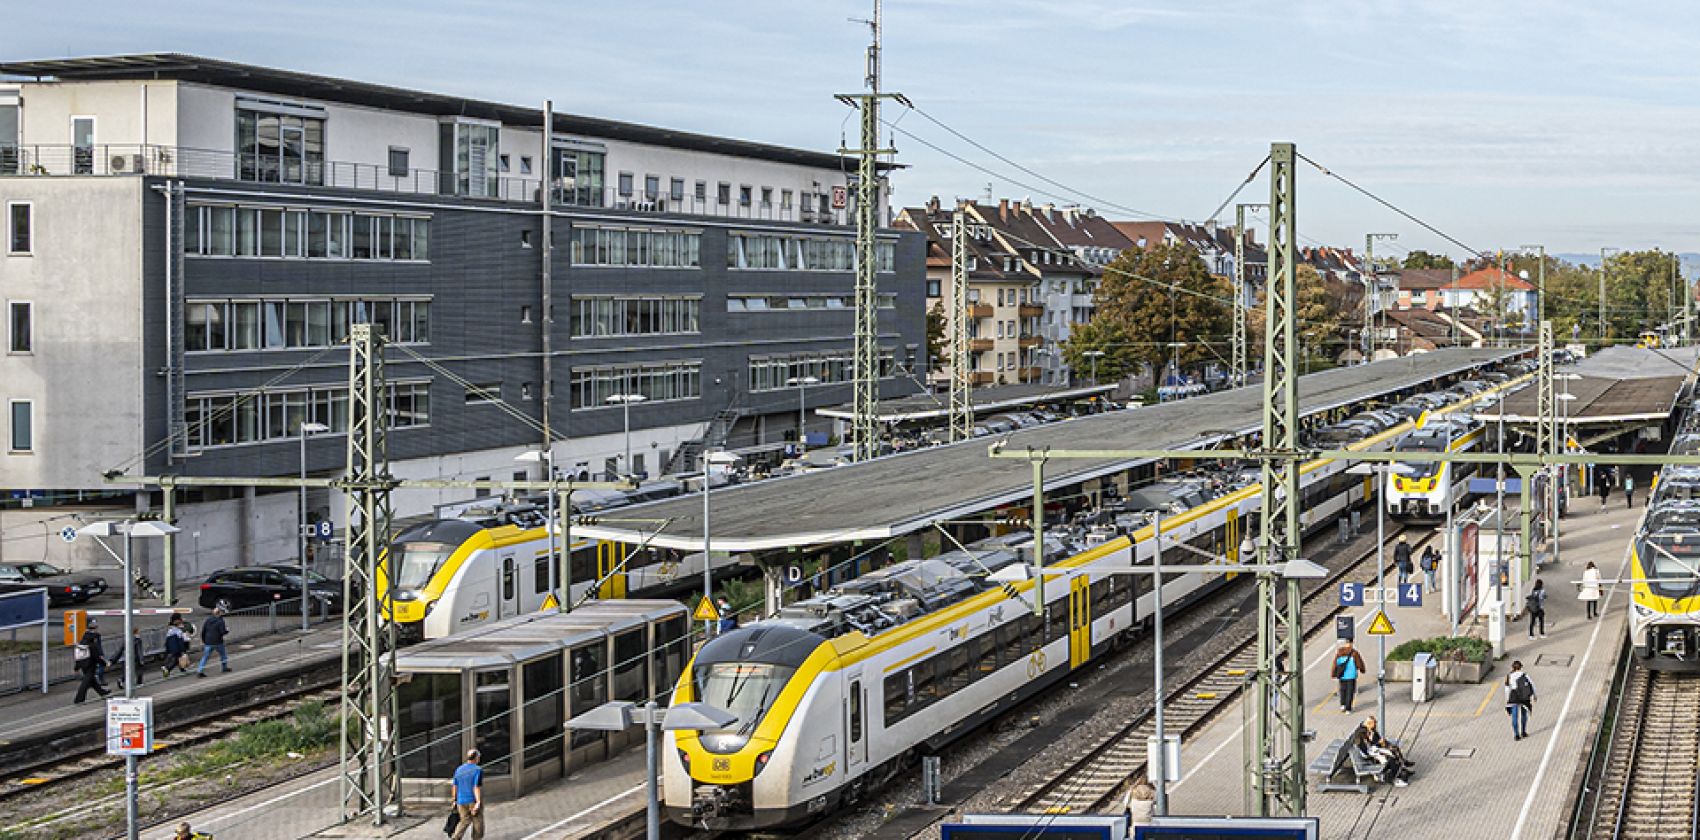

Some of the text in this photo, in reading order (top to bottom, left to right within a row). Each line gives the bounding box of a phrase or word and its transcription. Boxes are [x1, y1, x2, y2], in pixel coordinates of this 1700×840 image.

[321, 522, 330, 536] 8
[789, 566, 801, 581] D
[1342, 582, 1355, 602] 5
[1405, 583, 1419, 602] 4
